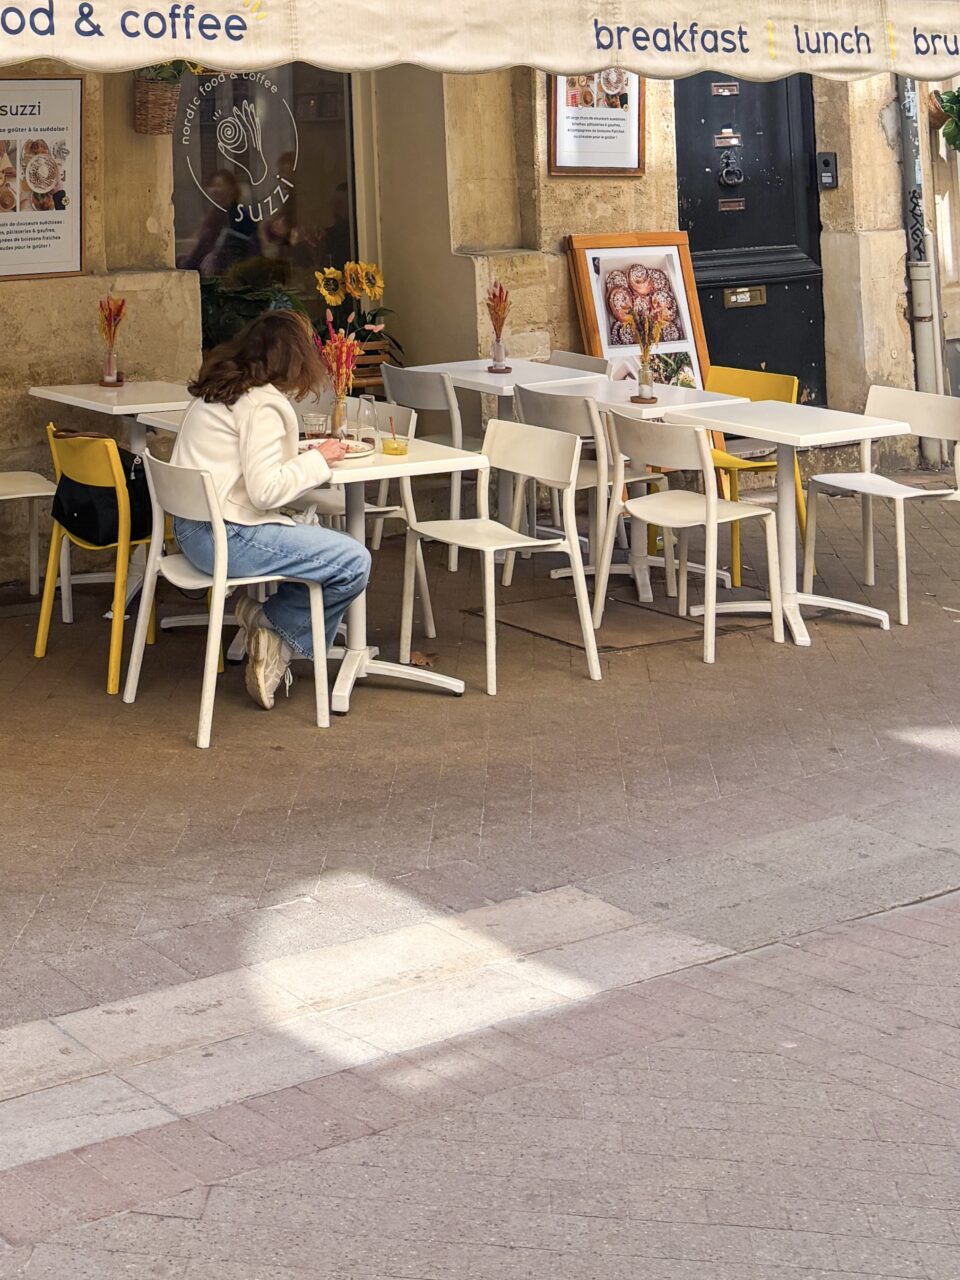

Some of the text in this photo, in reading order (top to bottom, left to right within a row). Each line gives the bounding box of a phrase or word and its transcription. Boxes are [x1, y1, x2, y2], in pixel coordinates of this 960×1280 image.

[74, 1, 105, 37] &
[120, 3, 248, 42] coffee
[593, 19, 750, 54] breakfast
[793, 24, 872, 55] lunch
[0, 101, 41, 116] suzzi
[182, 96, 201, 145] nordic
[199, 73, 226, 96] food
[242, 71, 278, 94] coffee
[234, 174, 294, 222] suzzi
